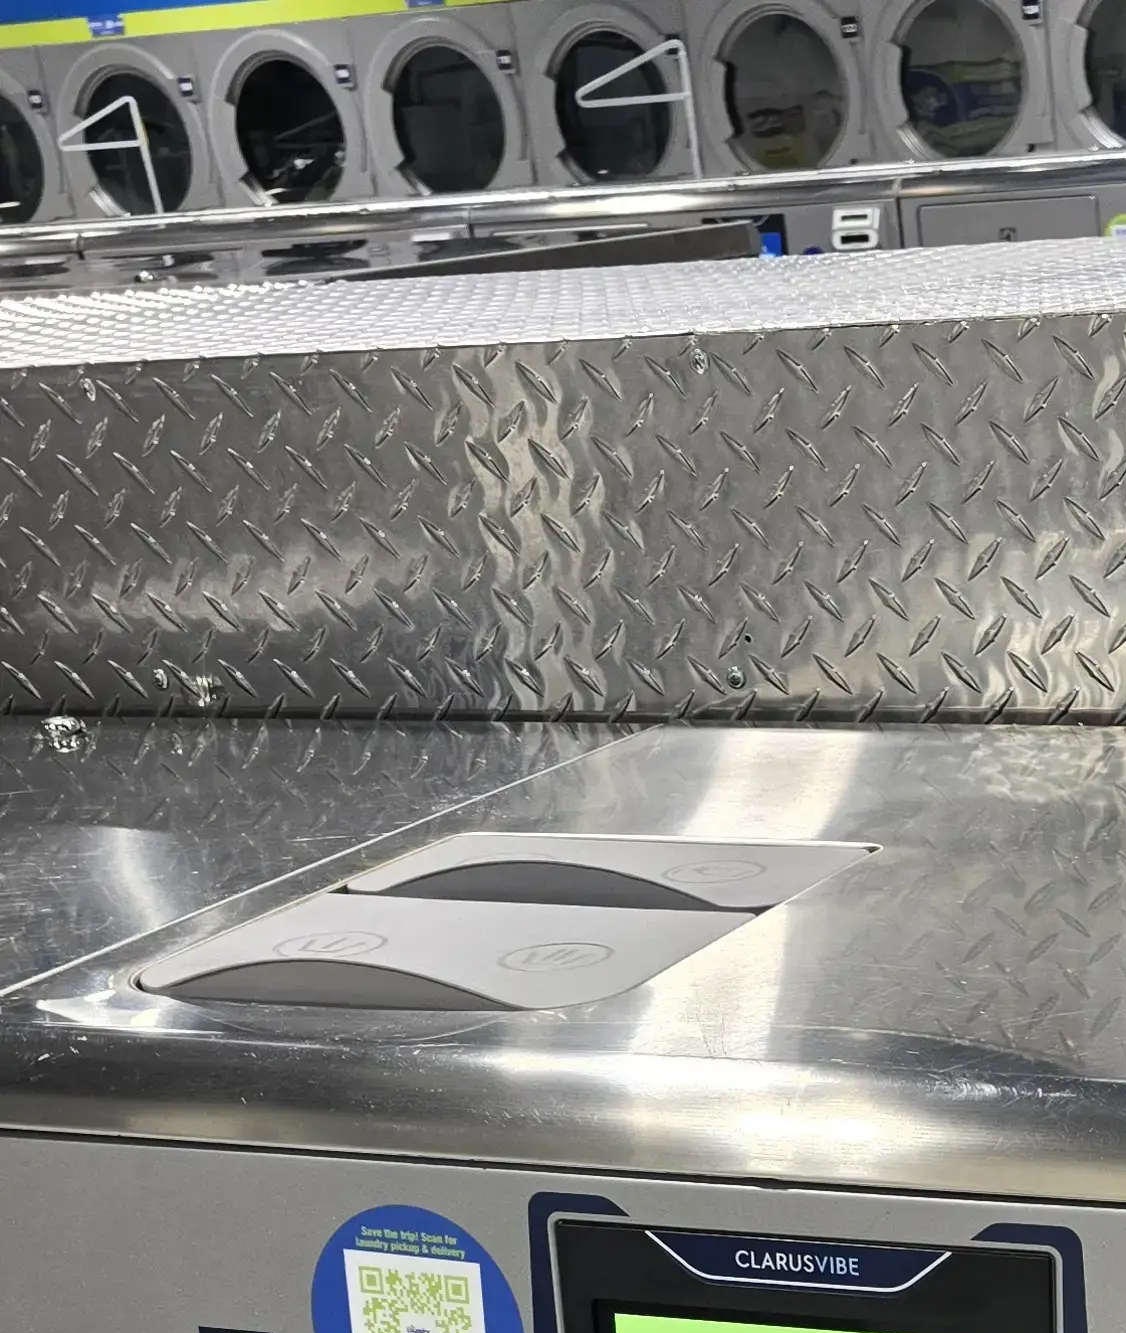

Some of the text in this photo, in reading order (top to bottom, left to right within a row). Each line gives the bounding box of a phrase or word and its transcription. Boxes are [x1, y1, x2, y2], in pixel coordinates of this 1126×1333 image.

[361, 1226, 383, 1238] Save
[421, 1232, 443, 1243] Scan
[391, 1241, 420, 1255] pickup
[421, 1244, 430, 1254] &
[431, 1245, 466, 1260] delivery
[735, 1250, 860, 1276] CLARUSVIBE
